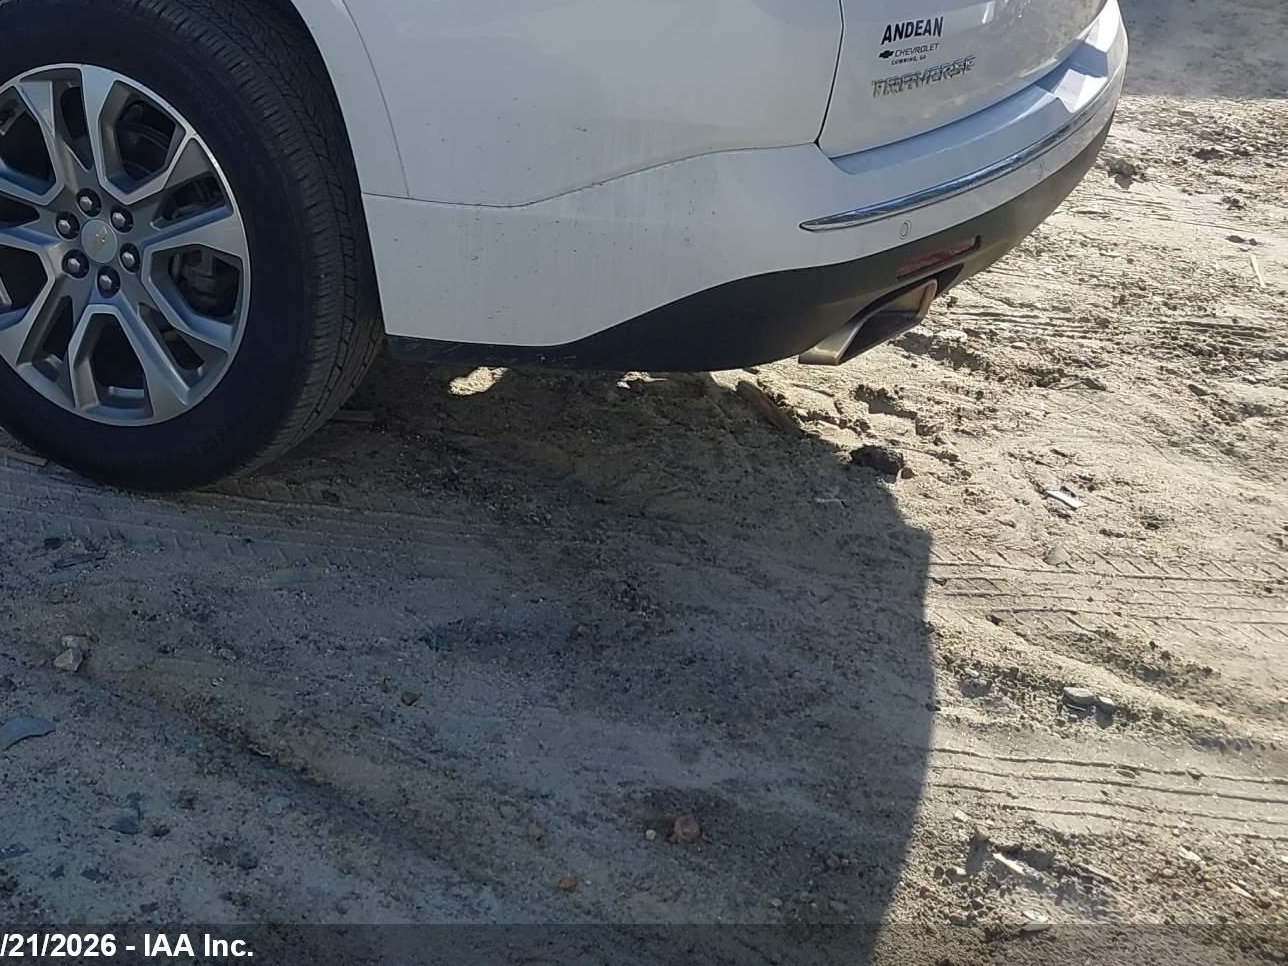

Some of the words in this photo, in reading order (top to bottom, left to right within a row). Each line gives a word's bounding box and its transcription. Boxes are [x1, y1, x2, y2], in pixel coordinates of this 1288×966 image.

[881, 16, 943, 45] ANDEAN
[895, 42, 939, 57] CHEVROLET
[872, 55, 975, 98] TRAVERSE
